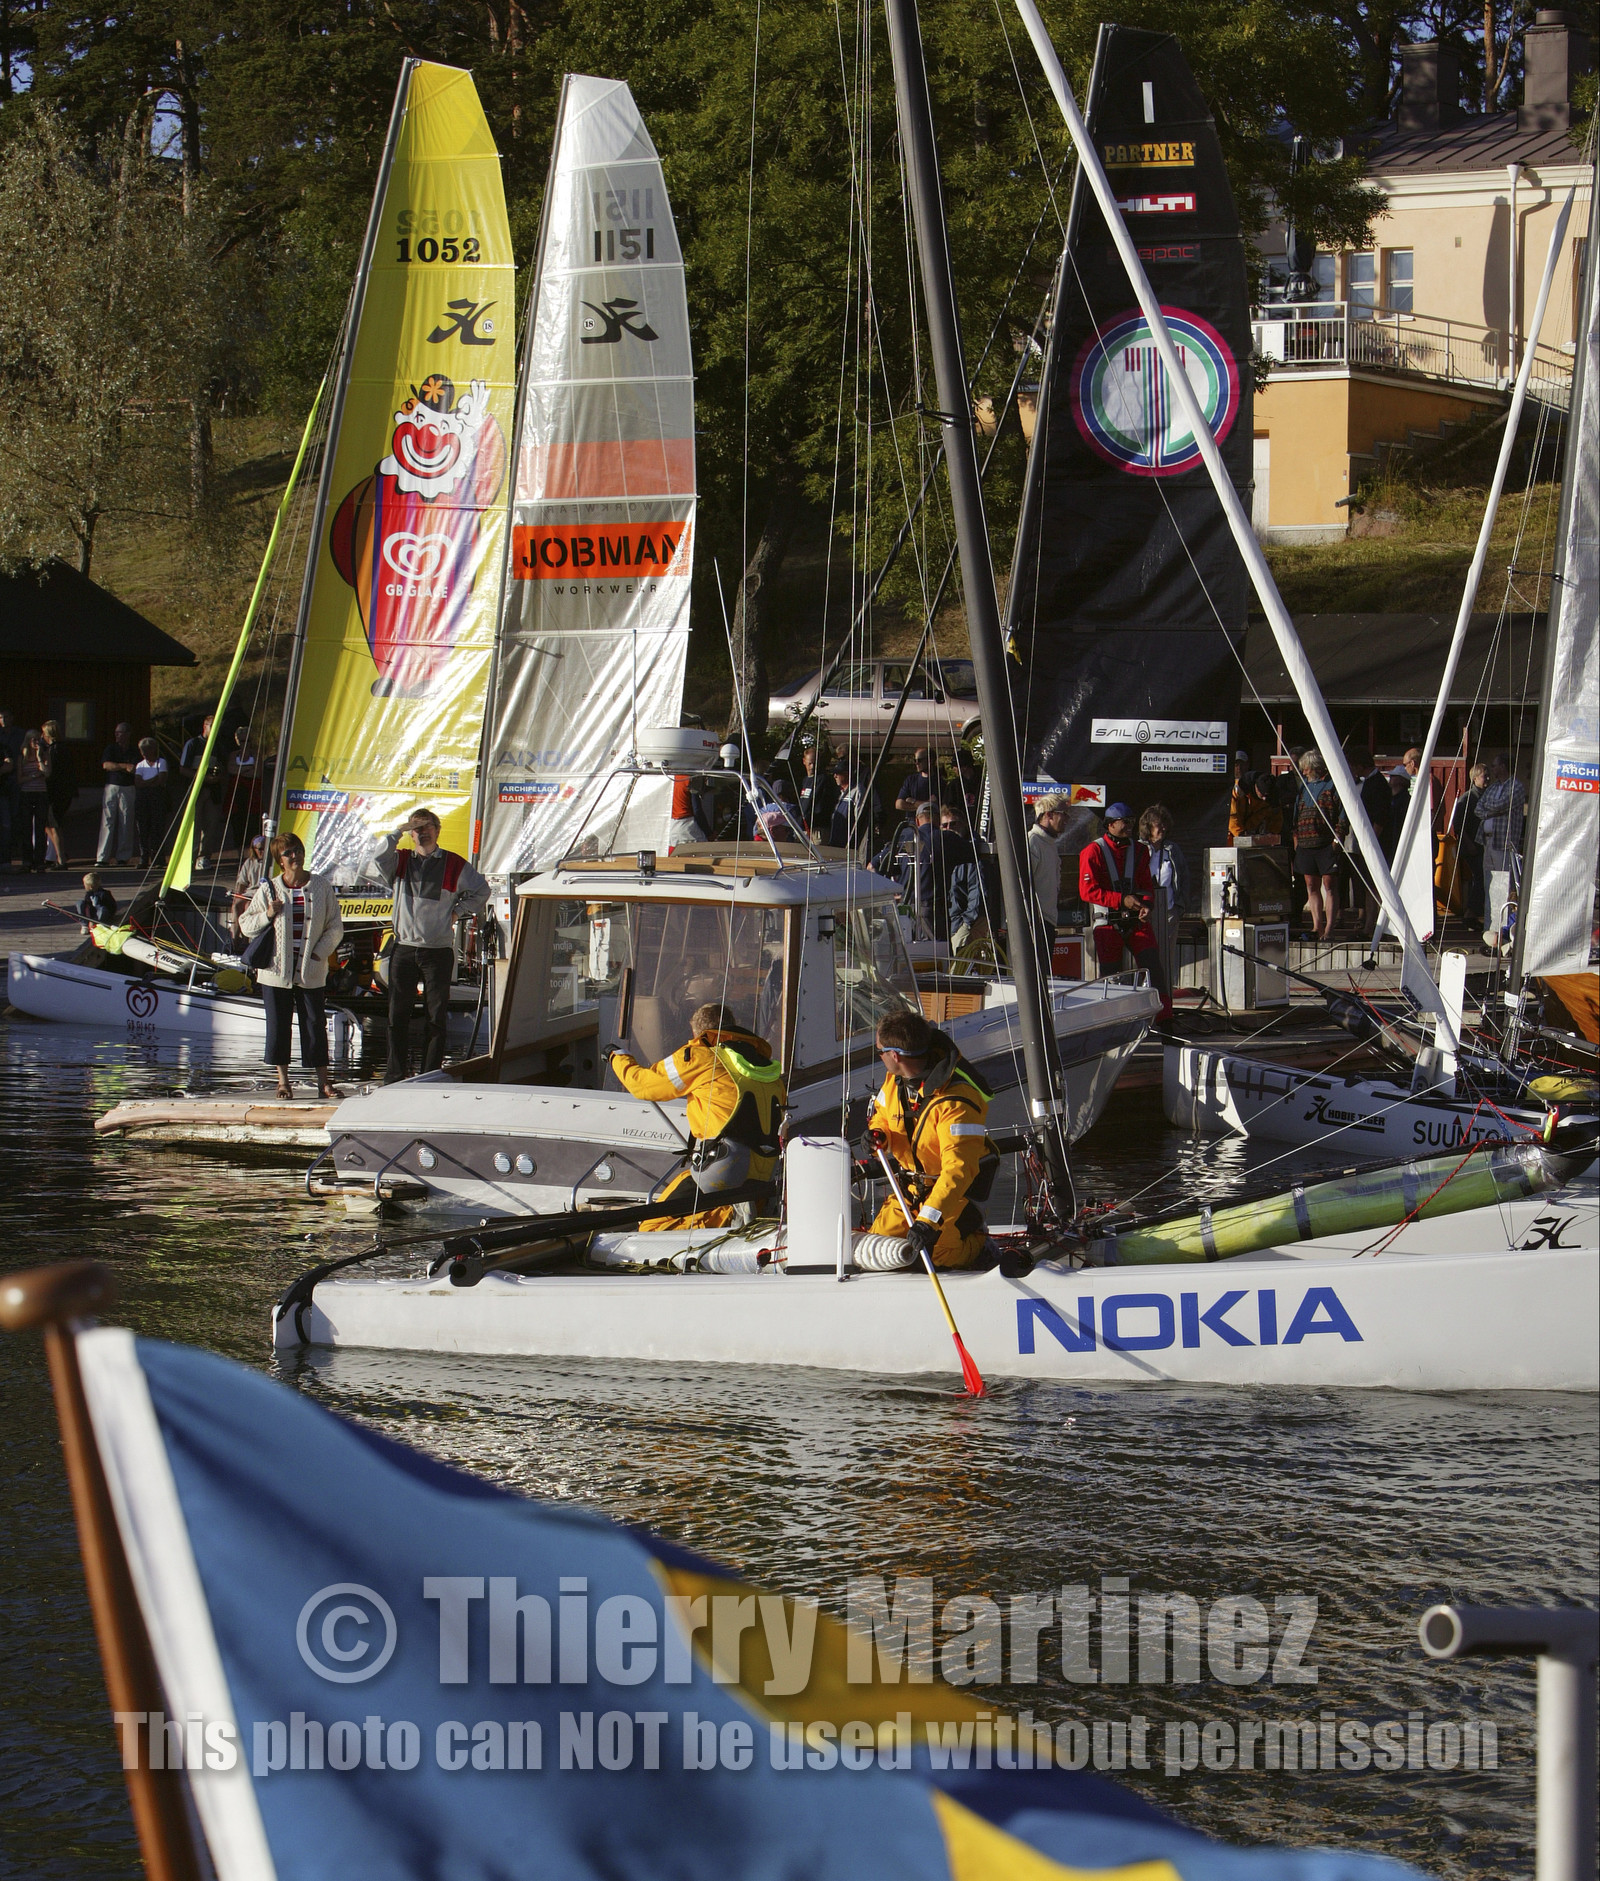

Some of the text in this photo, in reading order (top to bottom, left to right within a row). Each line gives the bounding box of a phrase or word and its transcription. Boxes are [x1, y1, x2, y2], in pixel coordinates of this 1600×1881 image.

[1104, 142, 1194, 163] PARTNER
[396, 237, 481, 263] 1052
[594, 228, 654, 262] 1151
[484, 322, 493, 330] 18
[585, 320, 594, 328] 18
[523, 534, 685, 568] JOBMAN
[385, 584, 404, 597] GB
[554, 584, 657, 595] WORKWEAR
[1095, 728, 1221, 740] SAIL RACING
[1142, 755, 1209, 764] Anders Lewander
[1142, 764, 1190, 772] Calle Hennix
[1561, 766, 1599, 777] ARCHI
[502, 785, 558, 793] ARCHIPELAGO
[1559, 778, 1593, 791] RAID
[289, 792, 346, 803] ARCHIPELAG
[288, 802, 313, 811] RAID
[1071, 911, 1082, 922] 95
[161, 954, 185, 967] HOBIE
[1328, 1109, 1385, 1126] HOBIE TIGER
[622, 1127, 674, 1140] WELLCRAFT
[1016, 1286, 1364, 1354] NOKIA
